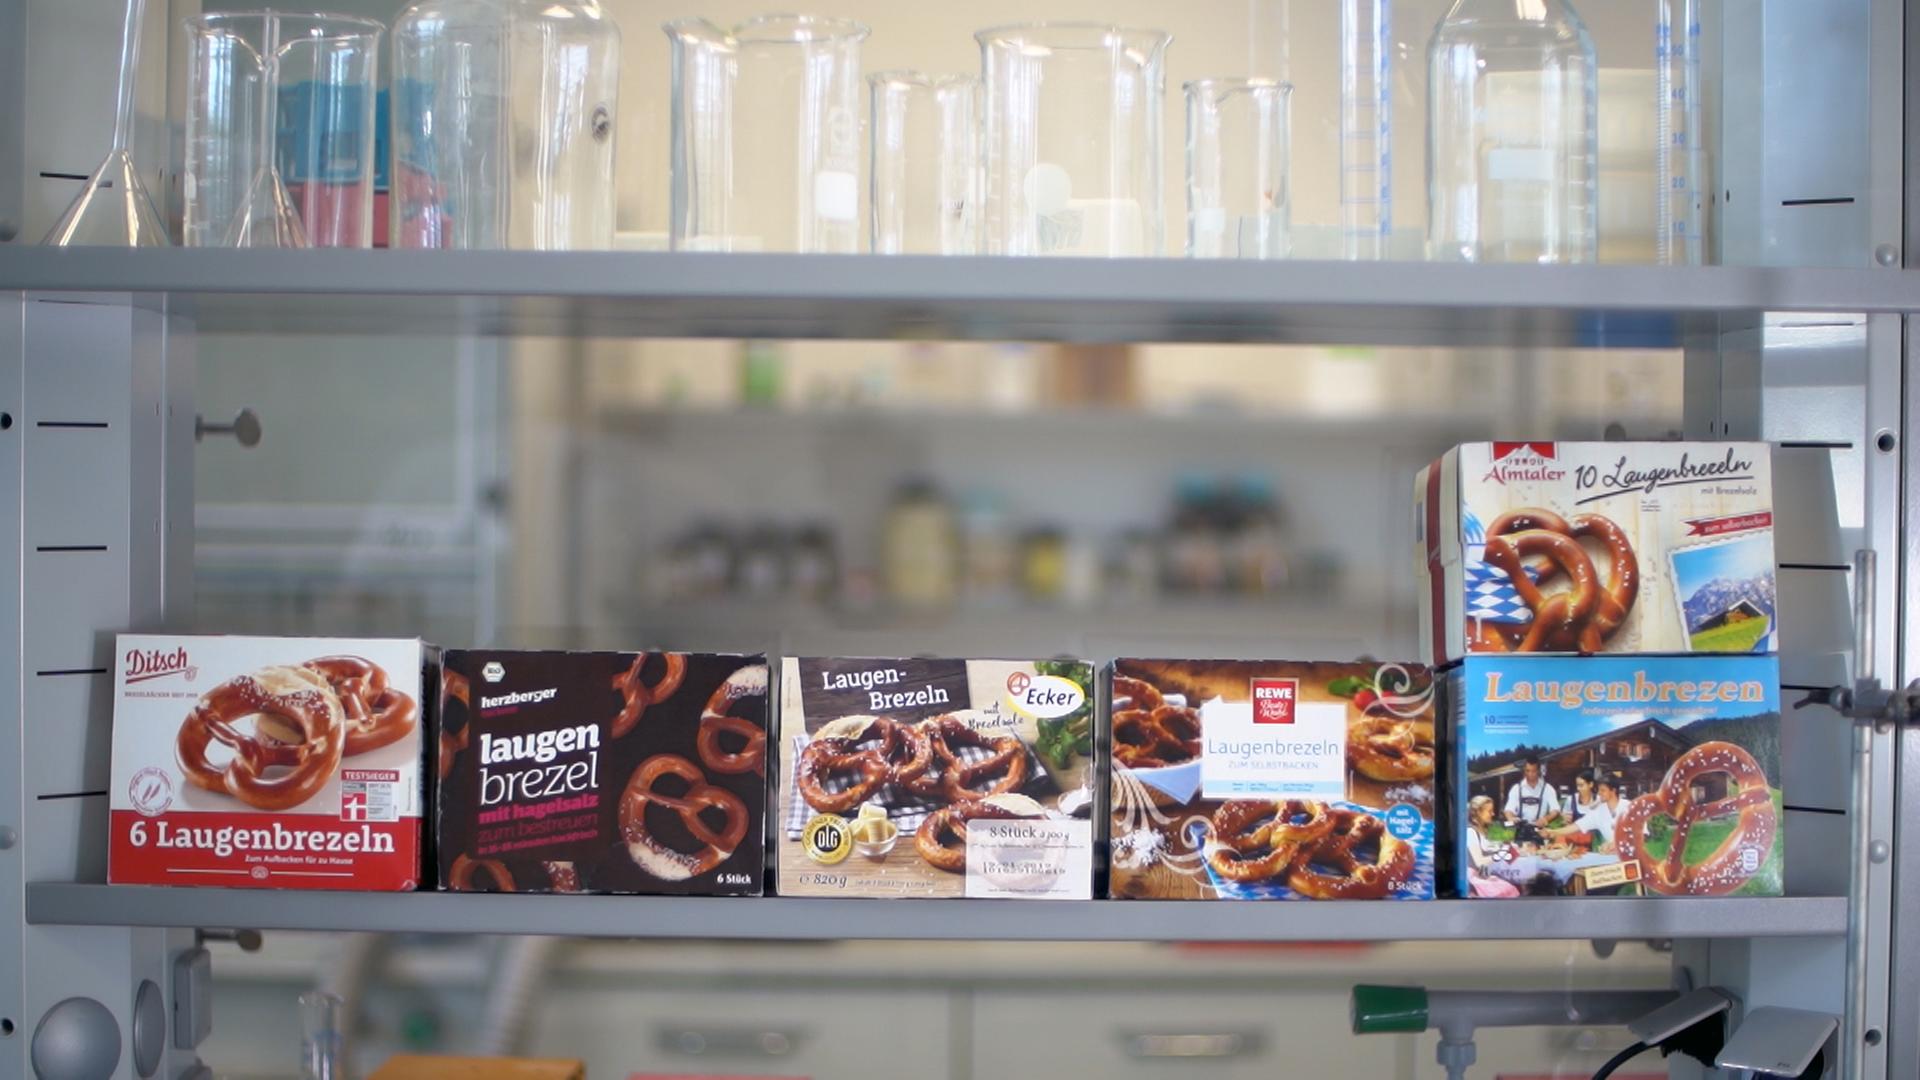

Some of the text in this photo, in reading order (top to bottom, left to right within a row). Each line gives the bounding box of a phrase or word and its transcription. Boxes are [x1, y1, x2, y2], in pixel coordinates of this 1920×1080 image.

[1671, 133, 1686, 144] 30
[1671, 177, 1685, 188] 20
[1672, 222, 1685, 232] 10
[1483, 462, 1567, 484] Almtaler
[1575, 447, 1752, 493] 10 Laugenbrezeln
[126, 646, 187, 676] Ditsch
[822, 668, 907, 691] Laugen-
[1484, 671, 1764, 709] Laugenbrezen
[481, 688, 558, 709] herzberger
[869, 684, 949, 710] Brezeln
[1026, 688, 1076, 706] Ecker
[1256, 687, 1293, 699] REWE
[480, 723, 600, 764] laugen
[1208, 739, 1339, 760] Laugenbrezeln
[480, 751, 599, 806] brezel
[479, 794, 599, 824] mit hagelsalz
[129, 821, 395, 857] 6 Laugenbrezeln
[479, 826, 514, 841] zum
[990, 825, 998, 838] 8
[1000, 825, 1037, 838] Stück
[305, 856, 317, 864] für
[717, 872, 752, 884] 6 Stück
[1388, 881, 1395, 891] 8
